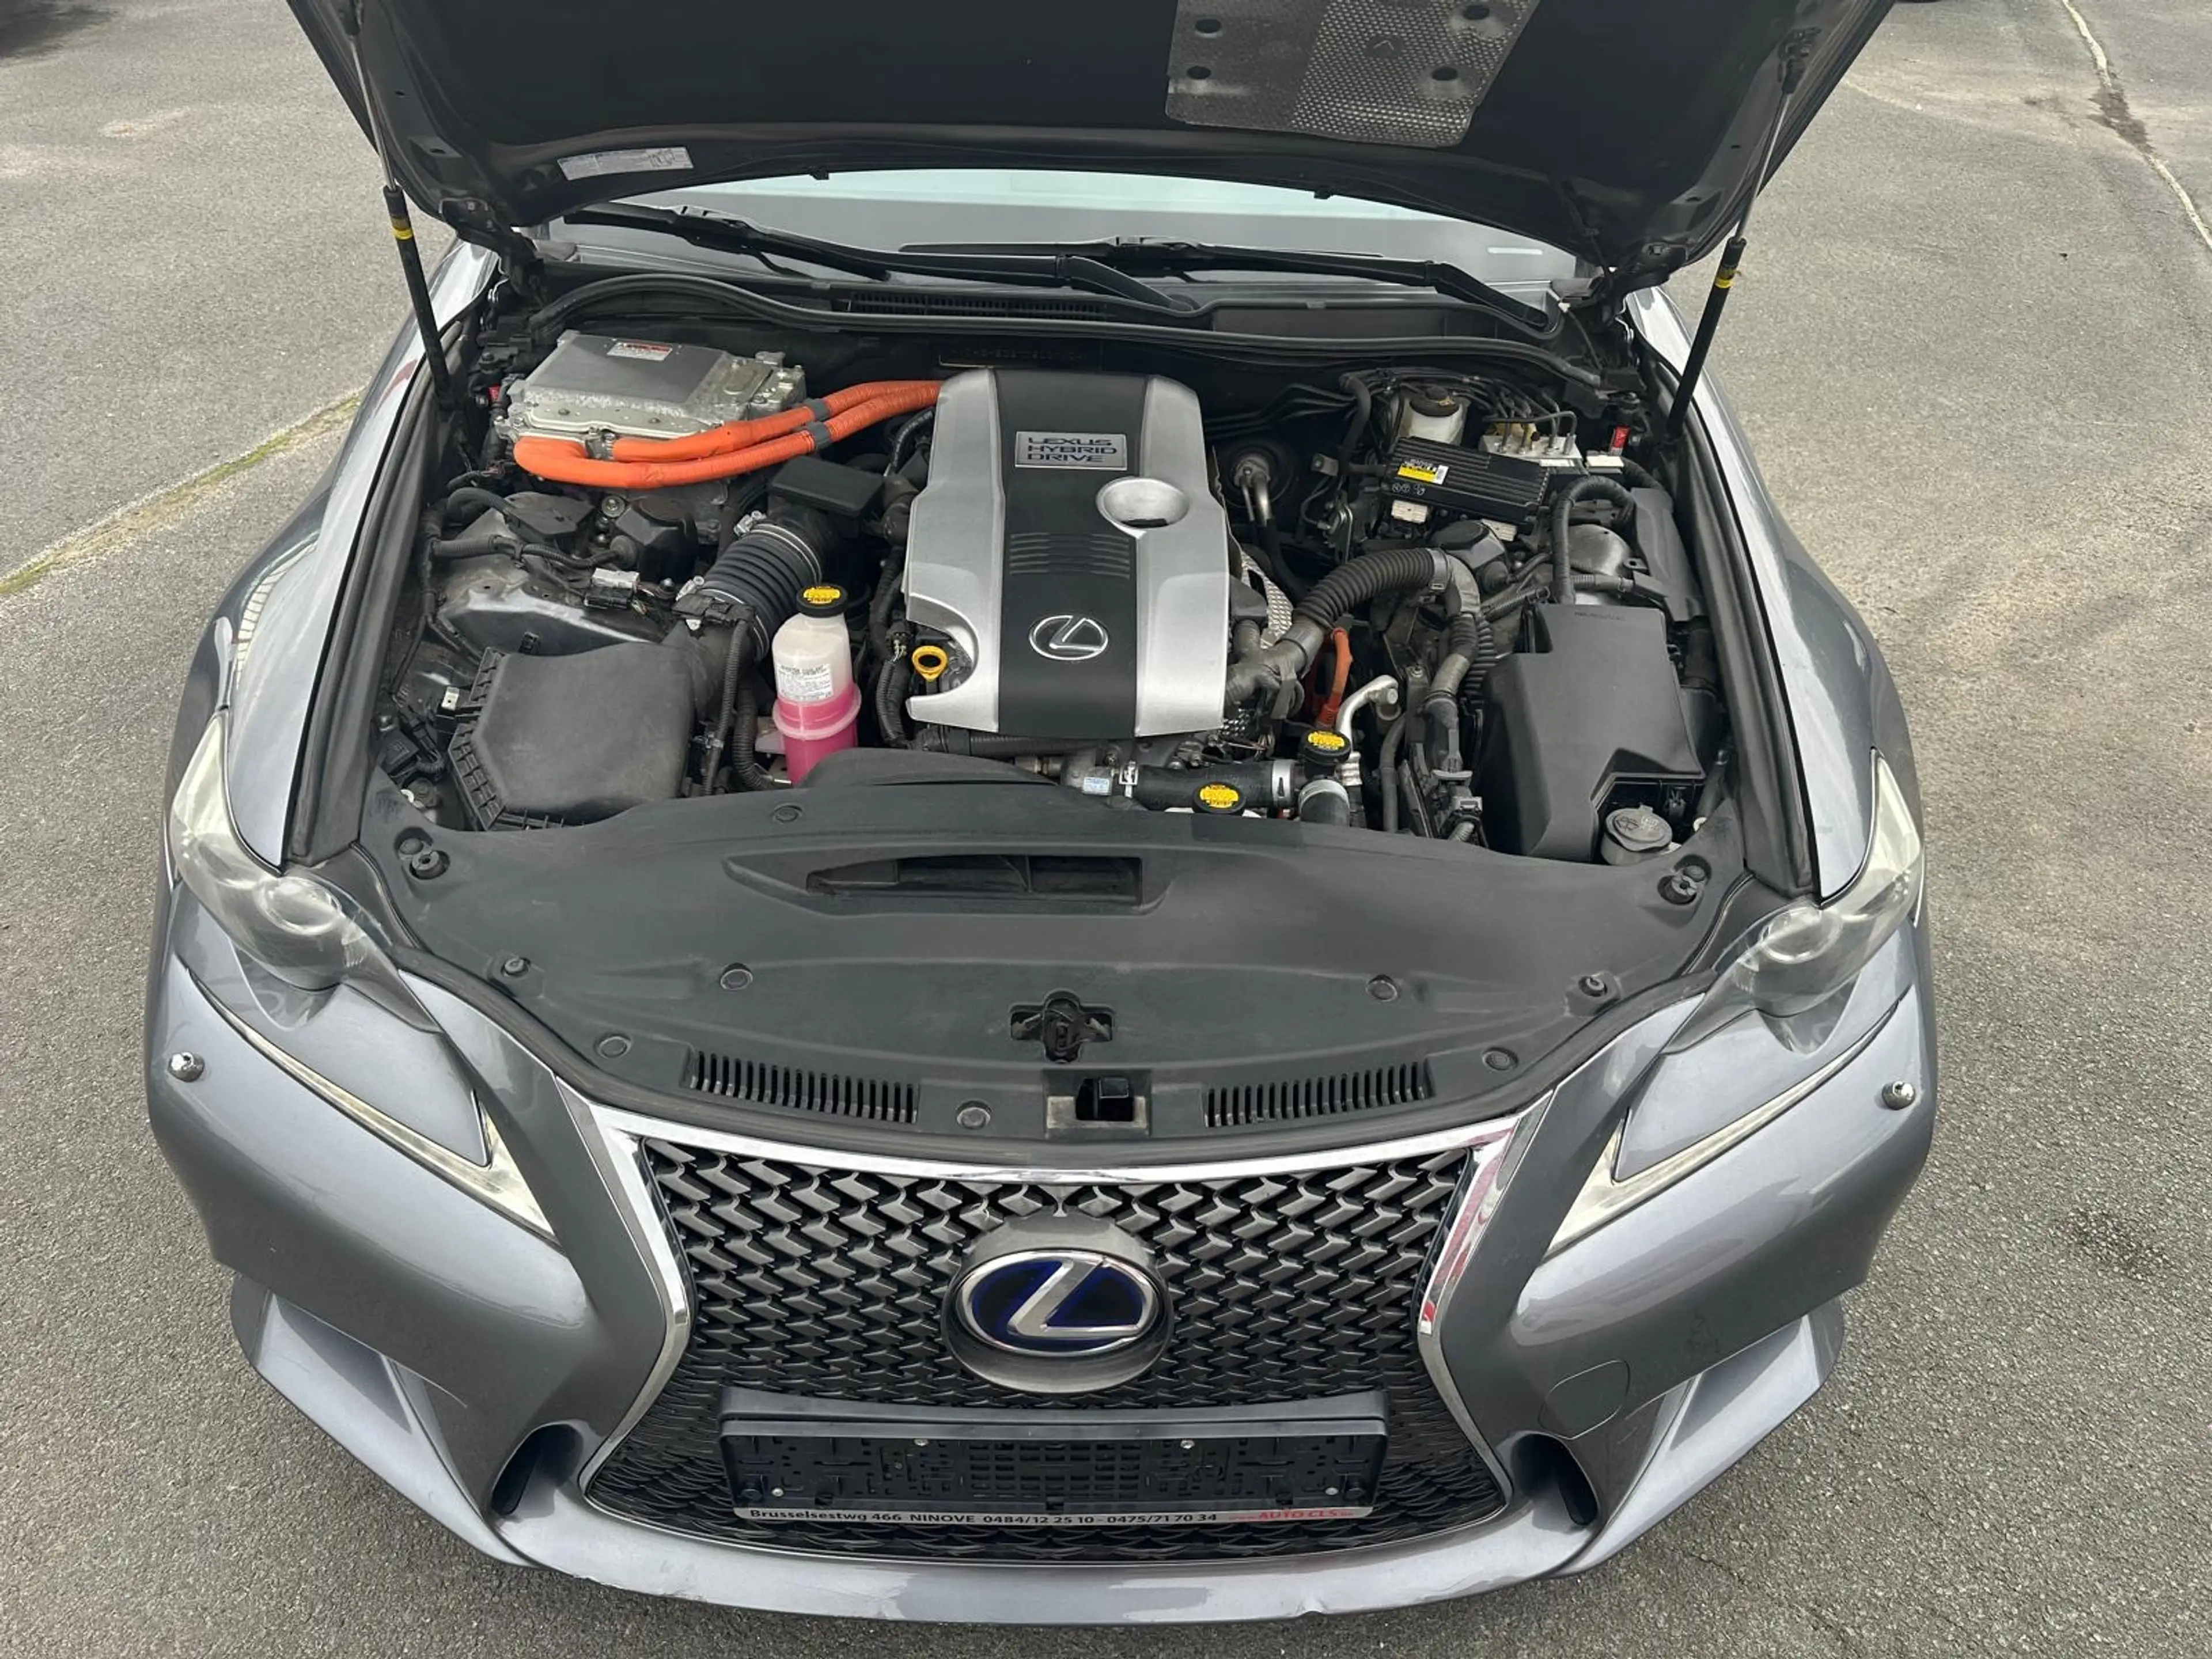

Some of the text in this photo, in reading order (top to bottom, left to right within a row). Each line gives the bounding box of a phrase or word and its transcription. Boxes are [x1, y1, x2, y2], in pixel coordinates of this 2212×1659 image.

[1028, 437, 1112, 446] LEXUS
[1028, 445, 1118, 454] HYBRID
[1027, 453, 1103, 462] DRIVE
[750, 1509, 867, 1522] Brusselsestwg
[872, 1513, 902, 1521] 466
[910, 1513, 975, 1523] NINOVE
[983, 1515, 1048, 1524] 0484/12
[1107, 1515, 1169, 1524] 0475/71
[1198, 1513, 1217, 1521] 34
